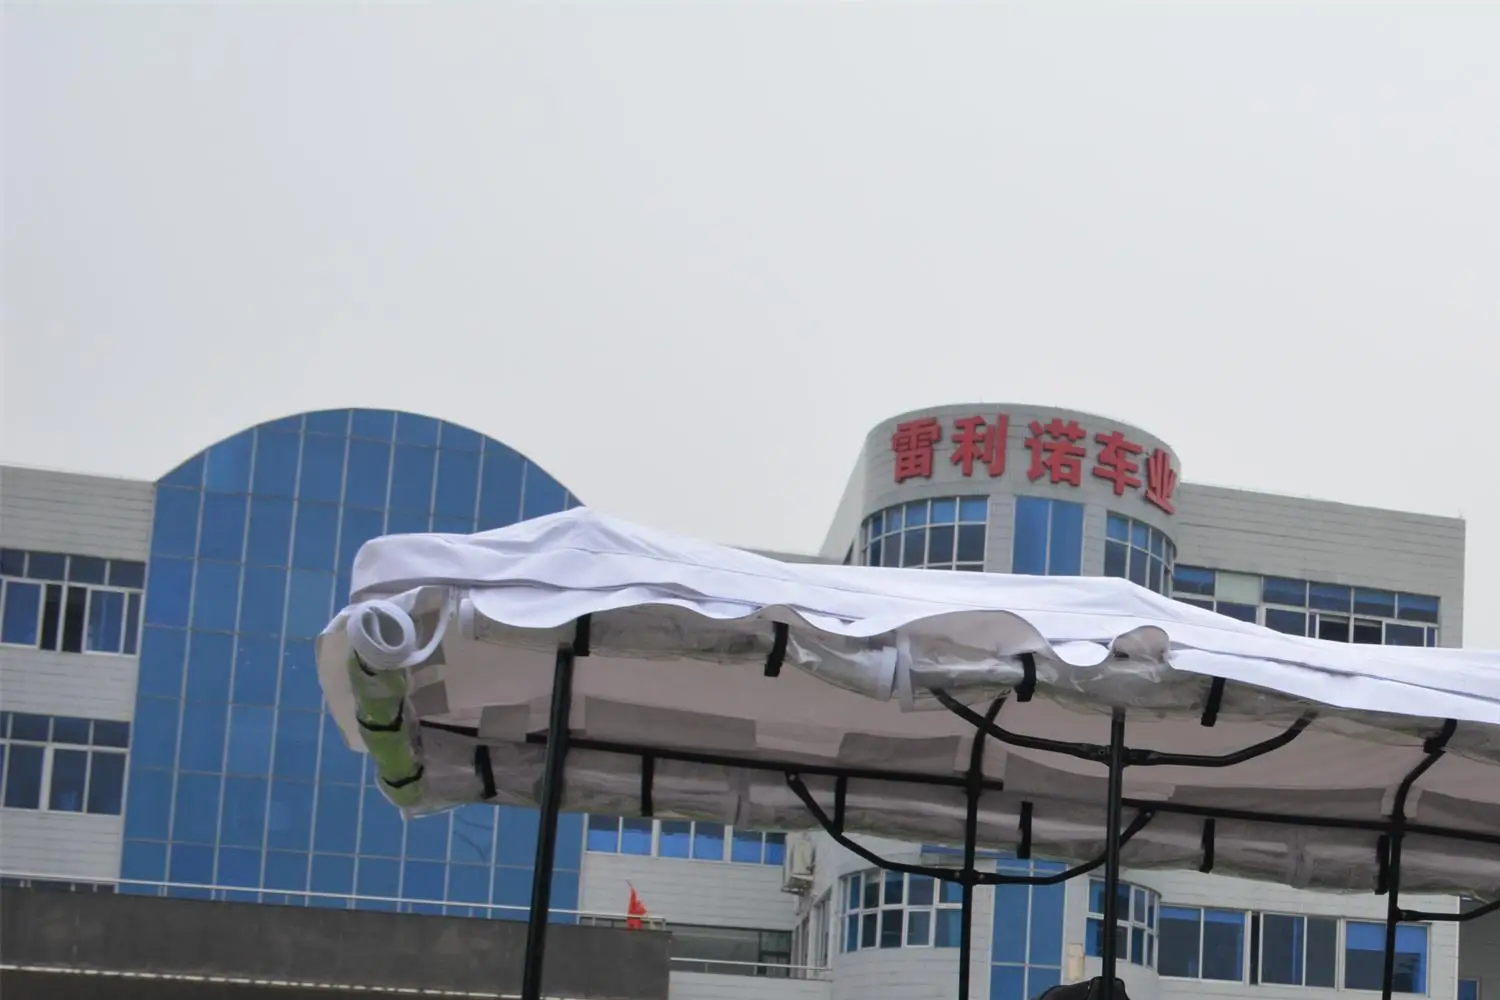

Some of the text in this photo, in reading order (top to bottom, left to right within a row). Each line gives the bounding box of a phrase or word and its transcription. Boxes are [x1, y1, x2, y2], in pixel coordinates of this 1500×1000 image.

[891, 413, 1177, 515] 雷利诺车业
